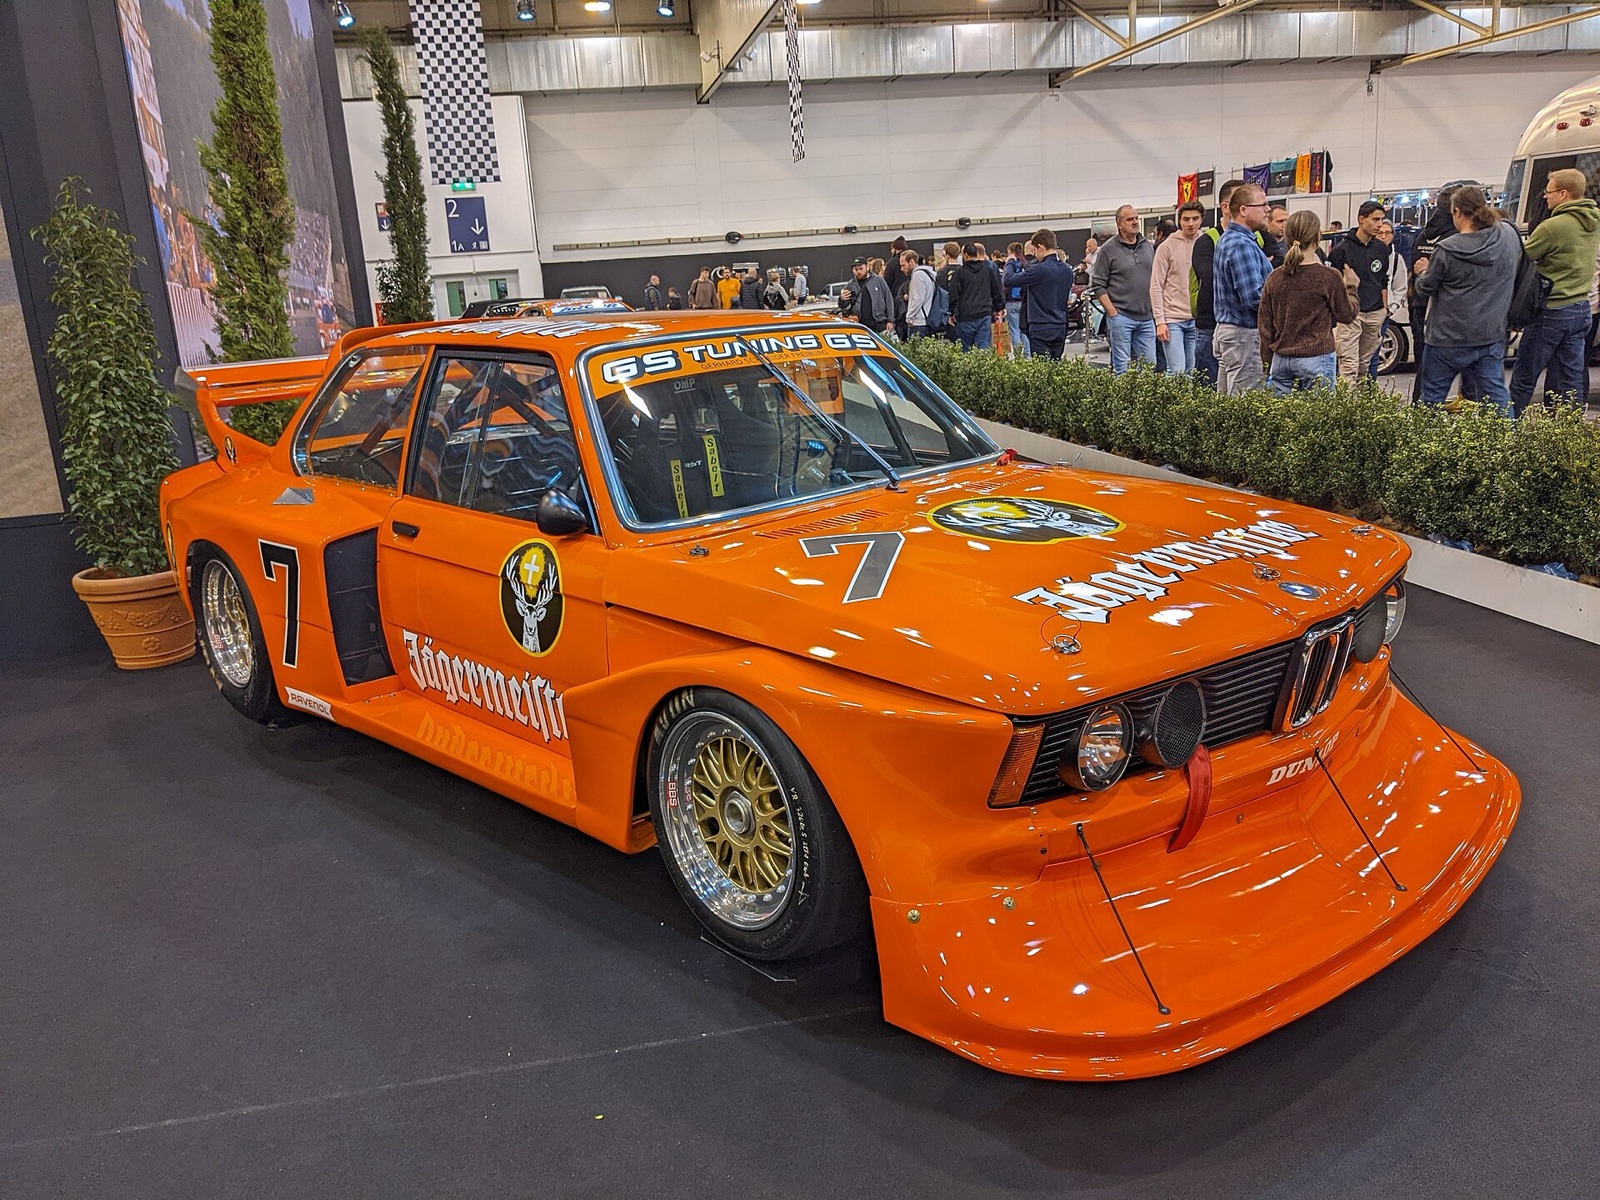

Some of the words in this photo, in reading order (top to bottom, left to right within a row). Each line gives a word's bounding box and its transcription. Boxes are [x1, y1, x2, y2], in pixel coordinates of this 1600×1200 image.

[446, 199, 460, 218] 2
[451, 240, 465, 252] 1A
[602, 349, 681, 385] GS
[683, 333, 823, 362] TUNING
[823, 333, 881, 351] GS
[701, 359, 743, 370] GERHARD
[791, 349, 829, 359] FREIBURG
[673, 378, 696, 391] OMP
[707, 438, 720, 492] Sabelt
[673, 464, 685, 518] Sabelt
[798, 531, 906, 604] 7
[258, 540, 300, 669] 7
[289, 693, 330, 715] RAVENOL
[668, 782, 678, 806] BBS
